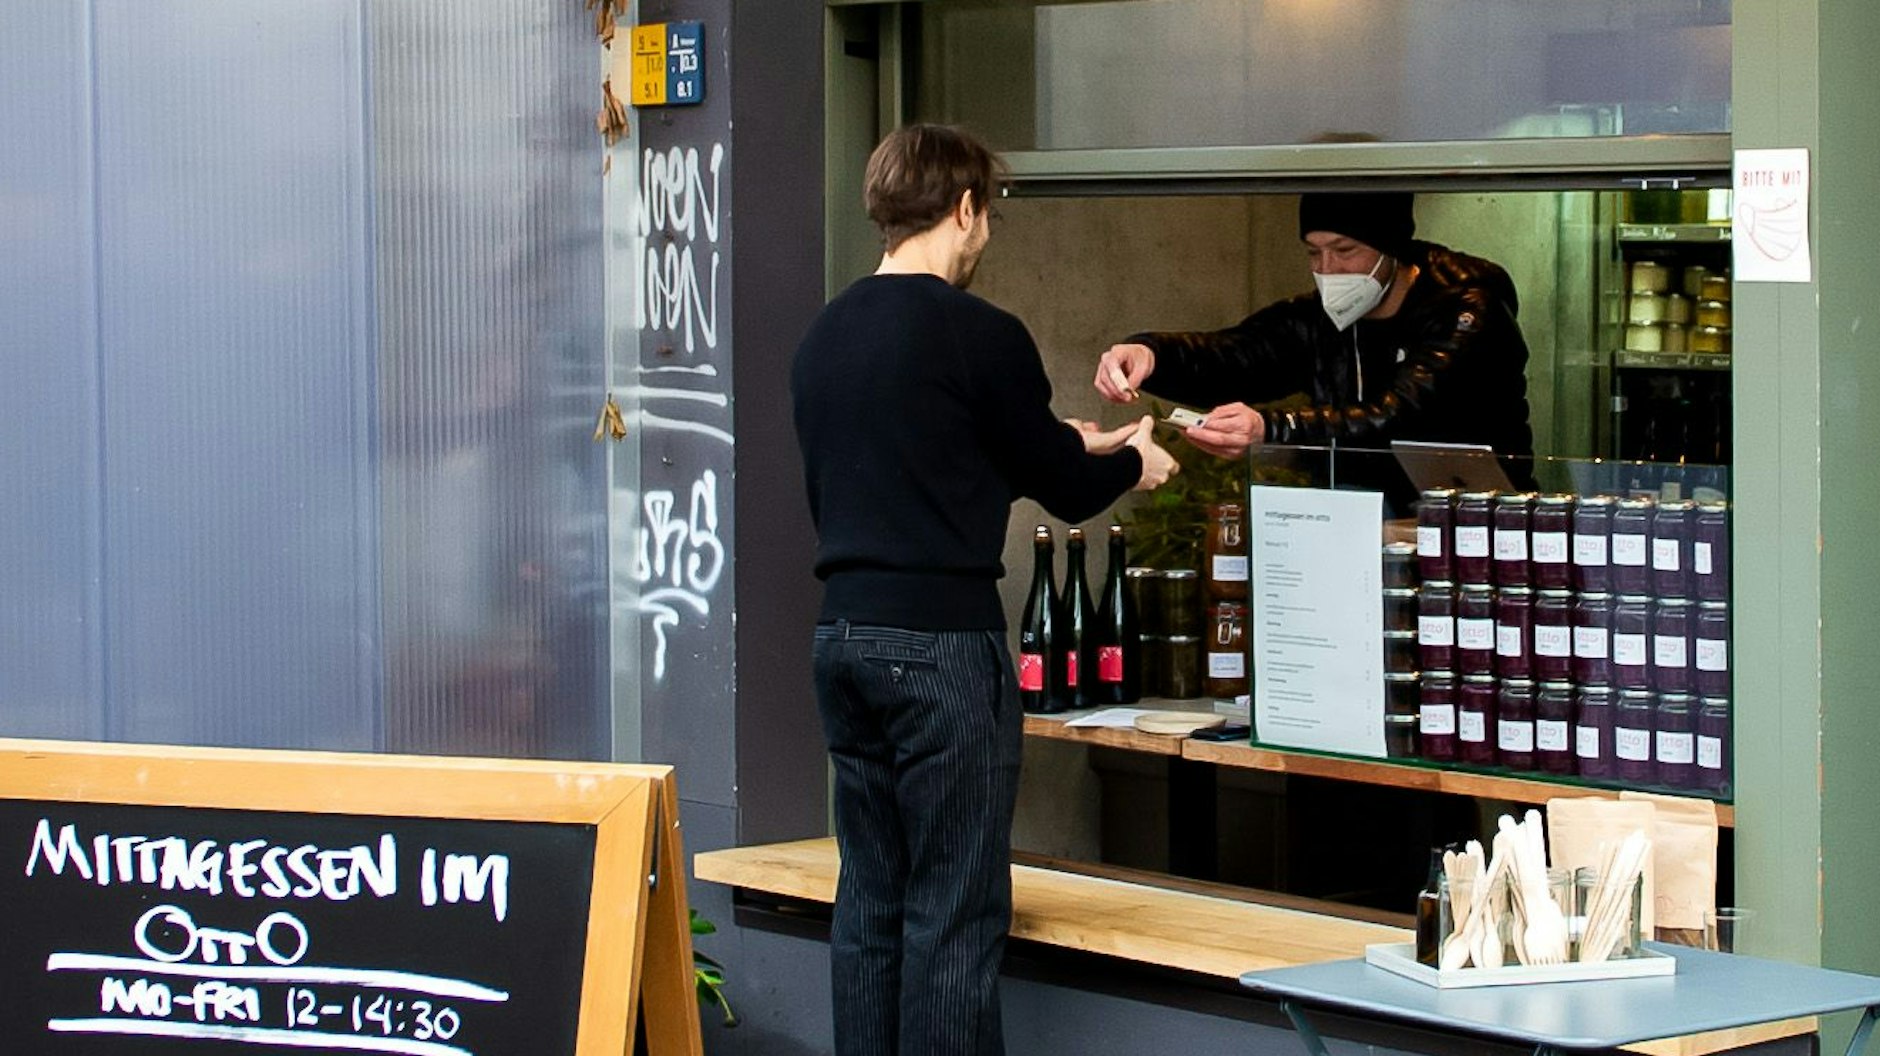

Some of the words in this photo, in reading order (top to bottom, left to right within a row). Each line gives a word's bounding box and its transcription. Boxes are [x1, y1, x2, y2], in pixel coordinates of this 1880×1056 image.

[1742, 170, 1774, 187] BITTE
[26, 819, 396, 900] MITTAGESSEN
[421, 848, 509, 922] IM
[101, 977, 261, 1022] MO-FRI
[286, 987, 460, 1039] 12-14:30
